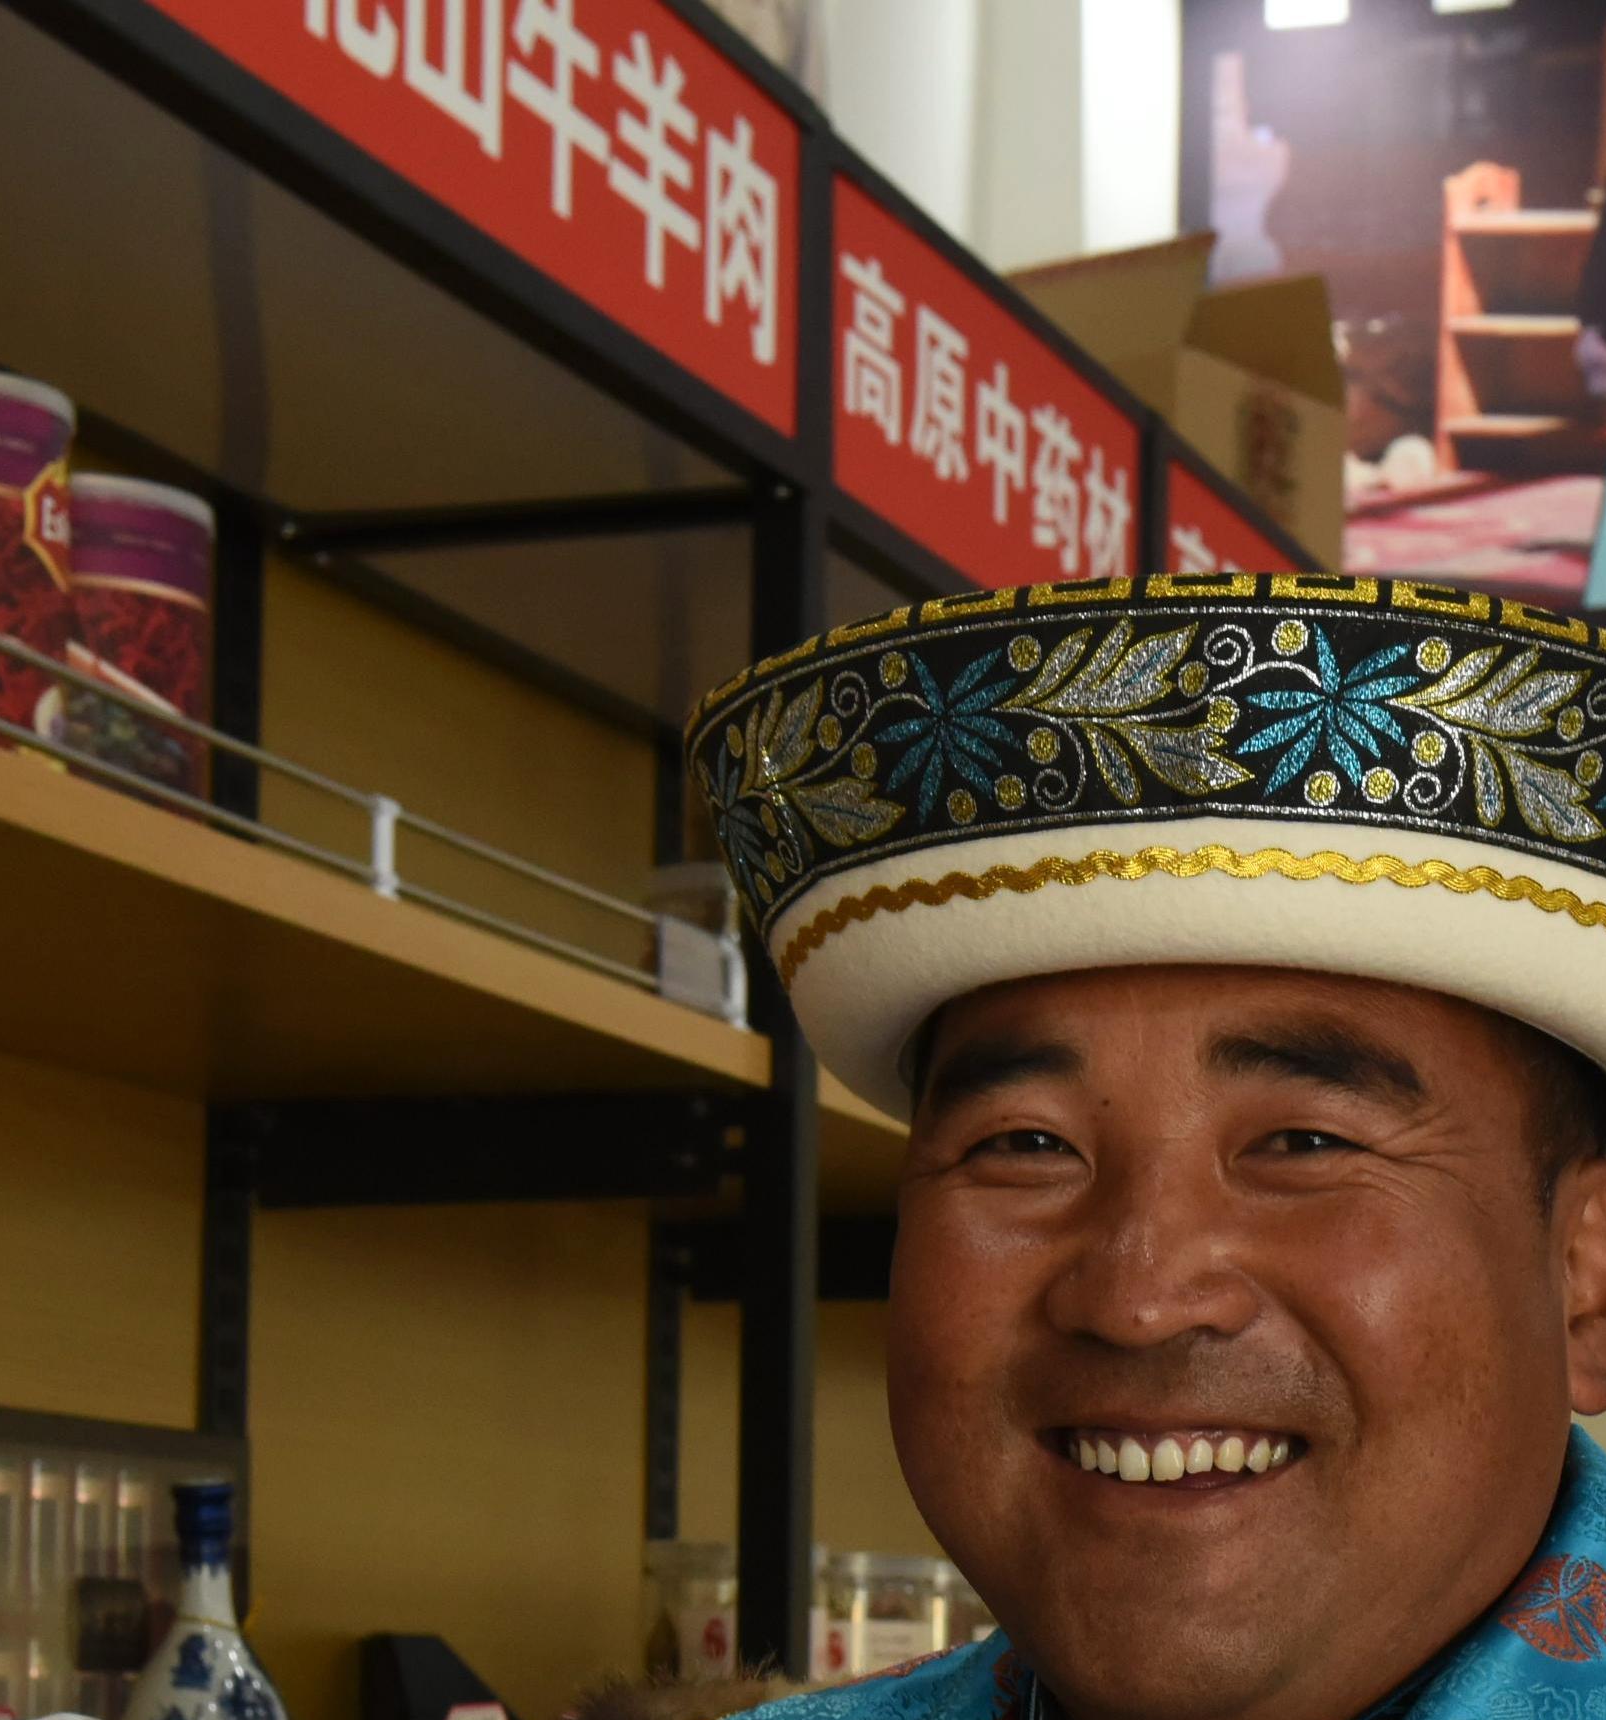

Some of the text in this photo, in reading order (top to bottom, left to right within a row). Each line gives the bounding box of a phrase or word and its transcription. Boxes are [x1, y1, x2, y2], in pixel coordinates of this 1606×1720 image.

[840, 250, 1130, 576] 高原中药材
